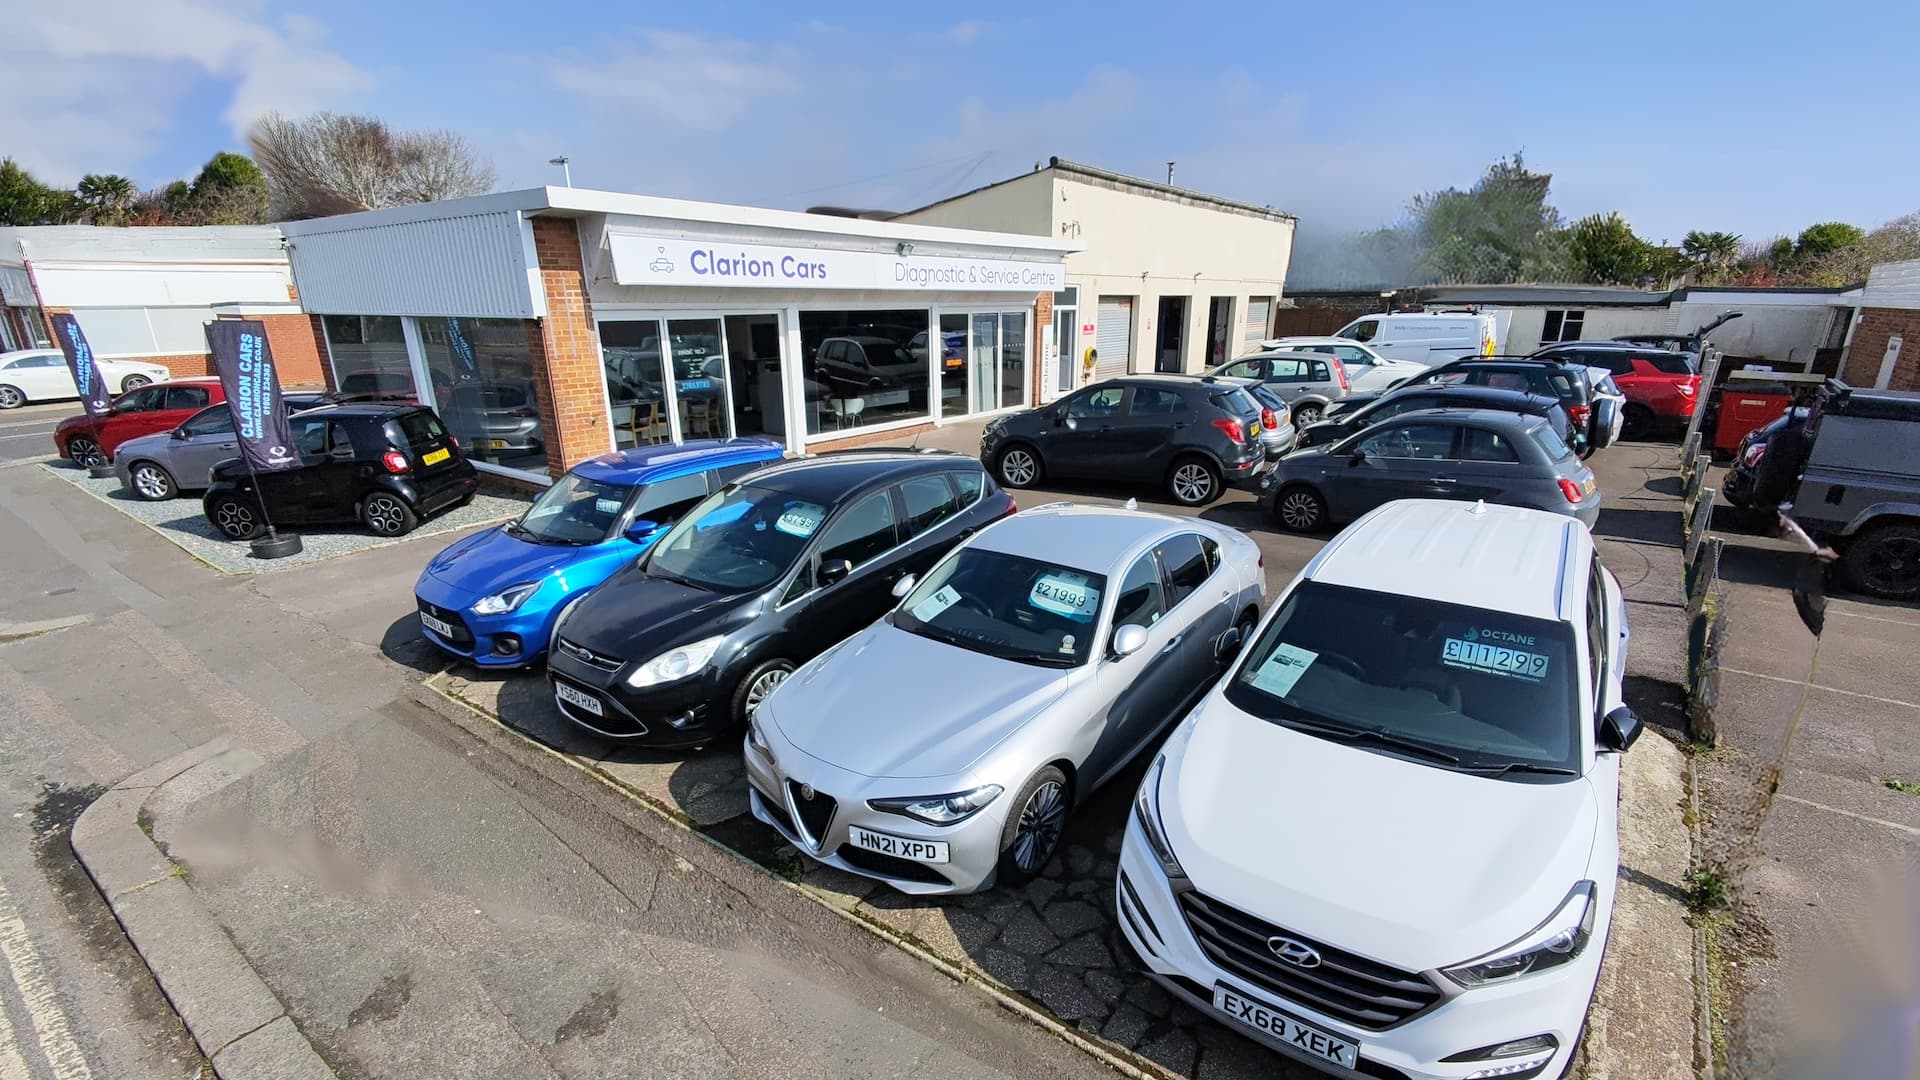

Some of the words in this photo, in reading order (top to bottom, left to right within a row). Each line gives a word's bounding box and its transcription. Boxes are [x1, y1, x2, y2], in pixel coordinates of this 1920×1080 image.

[690, 250, 774, 277] Clarion
[781, 255, 826, 279] Cars
[895, 262, 966, 287] Diagnostic
[968, 265, 977, 284] &
[980, 266, 1019, 285] Service
[1021, 268, 1056, 286] Centre
[239, 333, 254, 373] CARS
[239, 375, 253, 439] CLARION
[1035, 582, 1087, 608] £21999
[1481, 629, 1536, 646] OCTANE
[1445, 640, 1546, 674] £11299
[860, 831, 897, 854] HN21
[901, 841, 936, 859] XPD
[1223, 993, 1286, 1037] EX68
[1293, 1025, 1345, 1063] XEK
